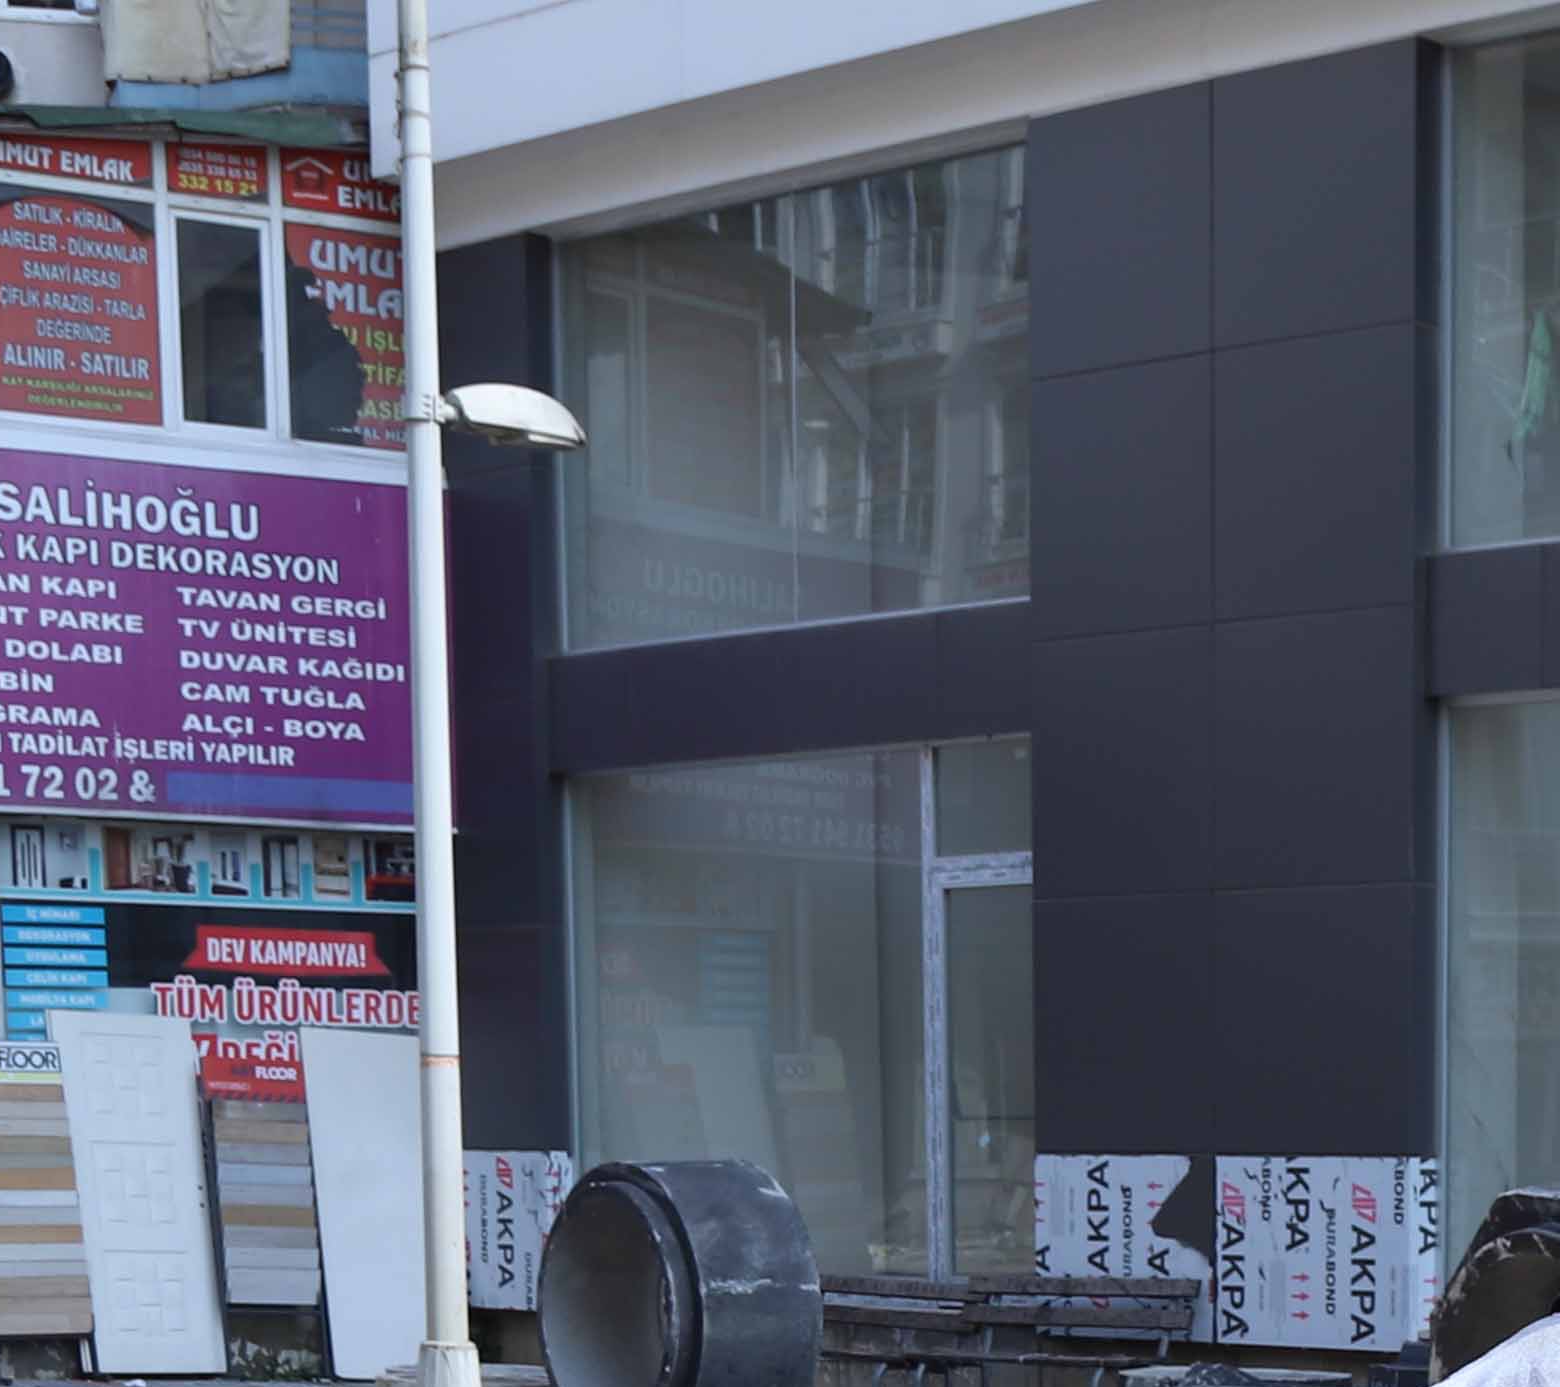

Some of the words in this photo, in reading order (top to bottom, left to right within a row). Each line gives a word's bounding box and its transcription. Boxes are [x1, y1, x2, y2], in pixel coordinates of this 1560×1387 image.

[59, 149, 135, 183] EMLAK
[177, 174, 209, 192] 332
[12, 200, 64, 226] SATILIK
[68, 234, 149, 265] DÜKKANLAR
[22, 259, 71, 282] SANAYİ
[73, 267, 121, 290] ARSASI
[103, 298, 147, 321] TARLA
[3, 343, 66, 371] ALINIR
[80, 351, 151, 381] SATILIR
[16, 532, 99, 567] KAPI
[110, 540, 339, 585] DEKORASYON
[41, 576, 118, 600] KAPI
[176, 587, 280, 613] TAVAN
[291, 596, 387, 620] GERGİ
[40, 607, 144, 634] PARKE
[178, 618, 220, 639] TV
[230, 619, 357, 649] ÜNİTESİ
[5, 638, 123, 665] DOLABI
[180, 650, 289, 676] DUVAR
[298, 657, 406, 683] KAĞIDI
[180, 682, 250, 704] CAM
[260, 685, 366, 711] TUĞLA
[182, 713, 254, 738] ALÇI
[283, 718, 366, 742] BOYA
[8, 729, 109, 758] TADİLAT
[113, 732, 195, 765] İŞLERİ
[200, 742, 295, 767] YAPILIR
[20, 764, 65, 800] 72
[74, 767, 118, 801] 02
[128, 769, 156, 803] &
[206, 937, 245, 963] DEV
[250, 940, 367, 969] KAMPANYA!
[151, 976, 225, 1023] TÜM
[233, 977, 421, 1030] ÜRÜNLERDE
[254, 1065, 298, 1082] FLOOR
[1086, 1159, 1110, 1274] AKPA
[496, 1190, 515, 1289] AKPA
[1221, 1221, 1250, 1338] AKPA
[1350, 1224, 1377, 1345] AKPA
